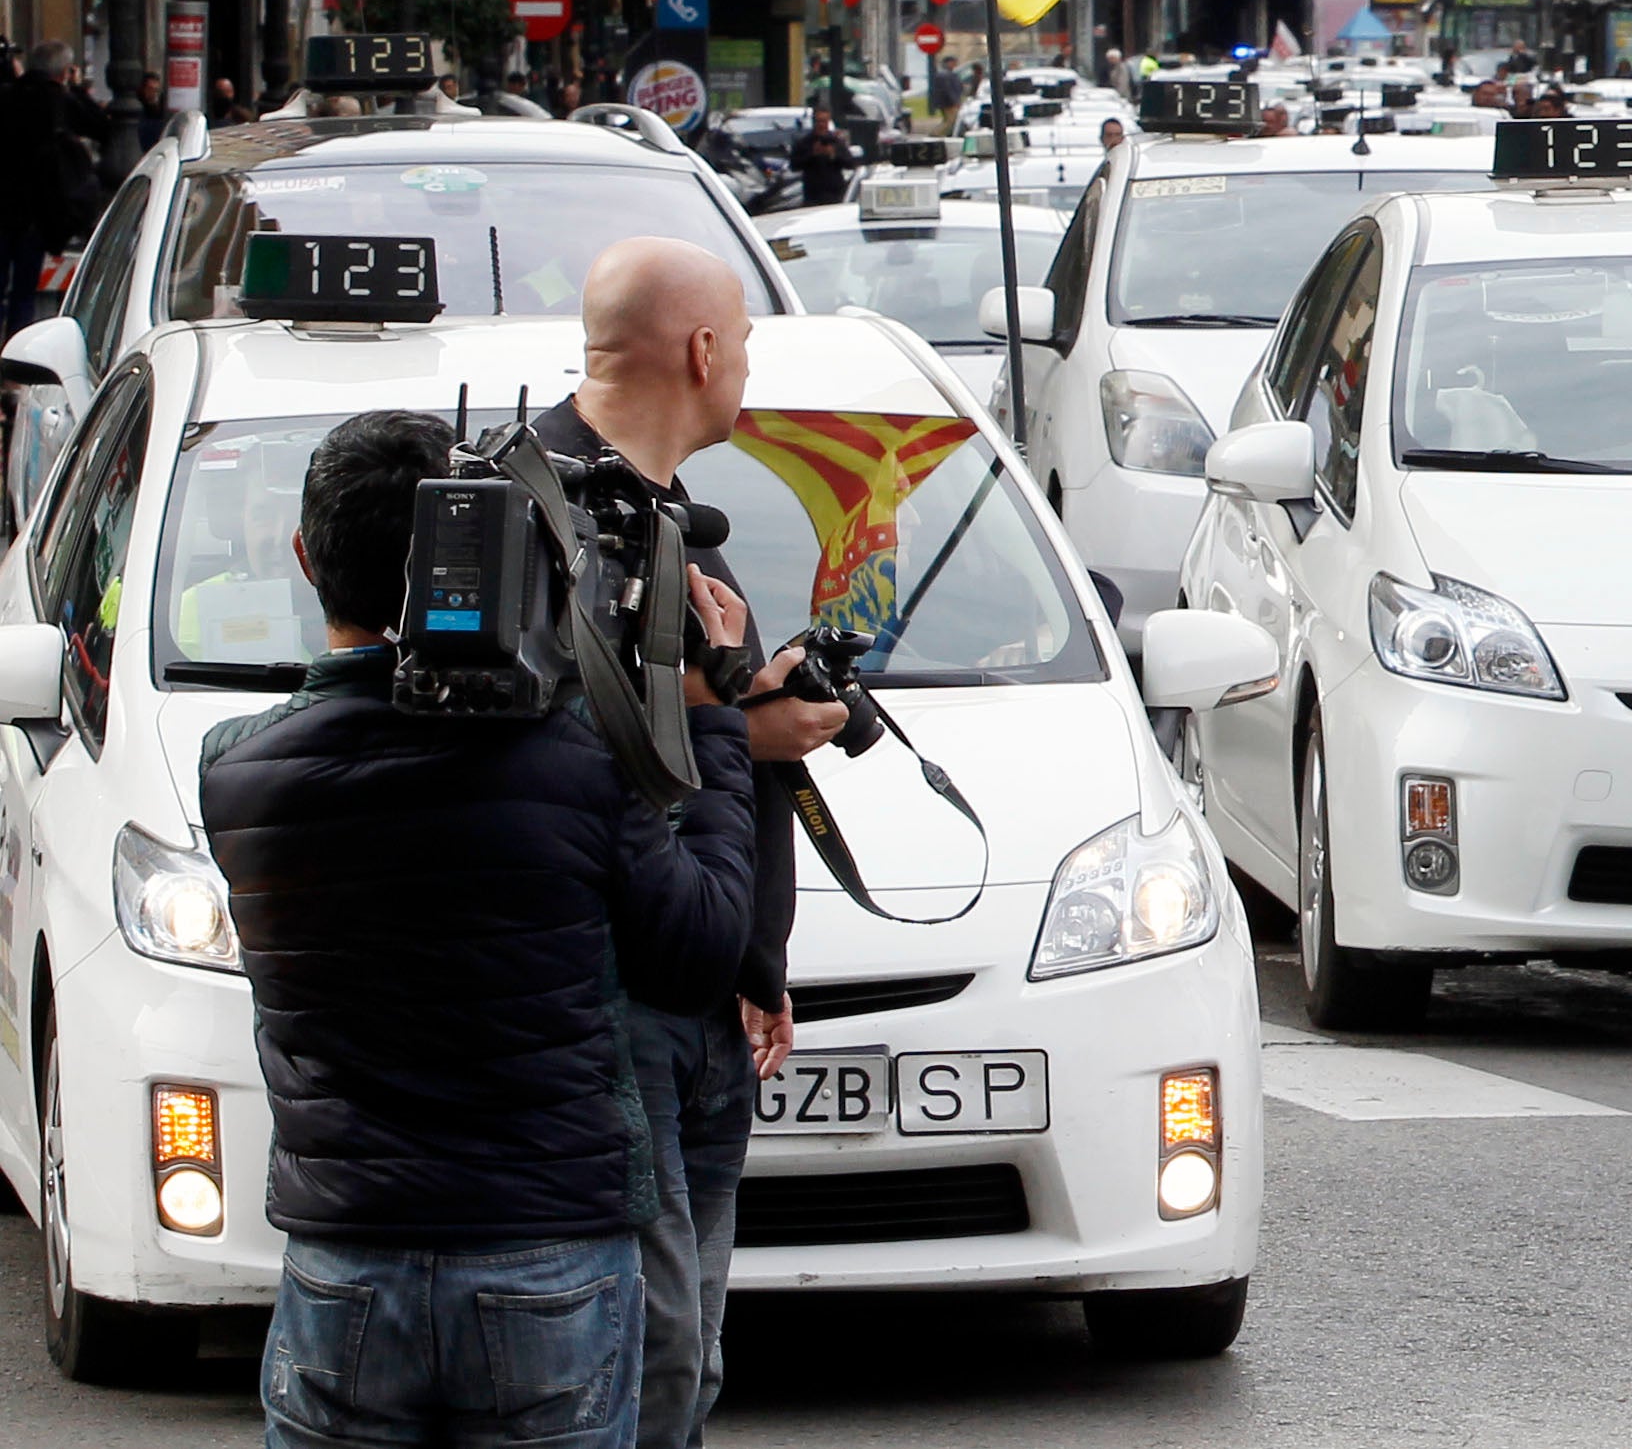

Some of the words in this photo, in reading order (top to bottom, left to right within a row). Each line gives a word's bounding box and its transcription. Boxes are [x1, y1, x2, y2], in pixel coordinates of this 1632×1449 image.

[344, 37, 426, 73] 123
[637, 76, 694, 102] BURGER
[1173, 84, 1246, 120] 123
[303, 241, 427, 298] 123
[795, 787, 829, 837] Nikon
[755, 1066, 871, 1124] GZB
[920, 1061, 1027, 1122] SP
